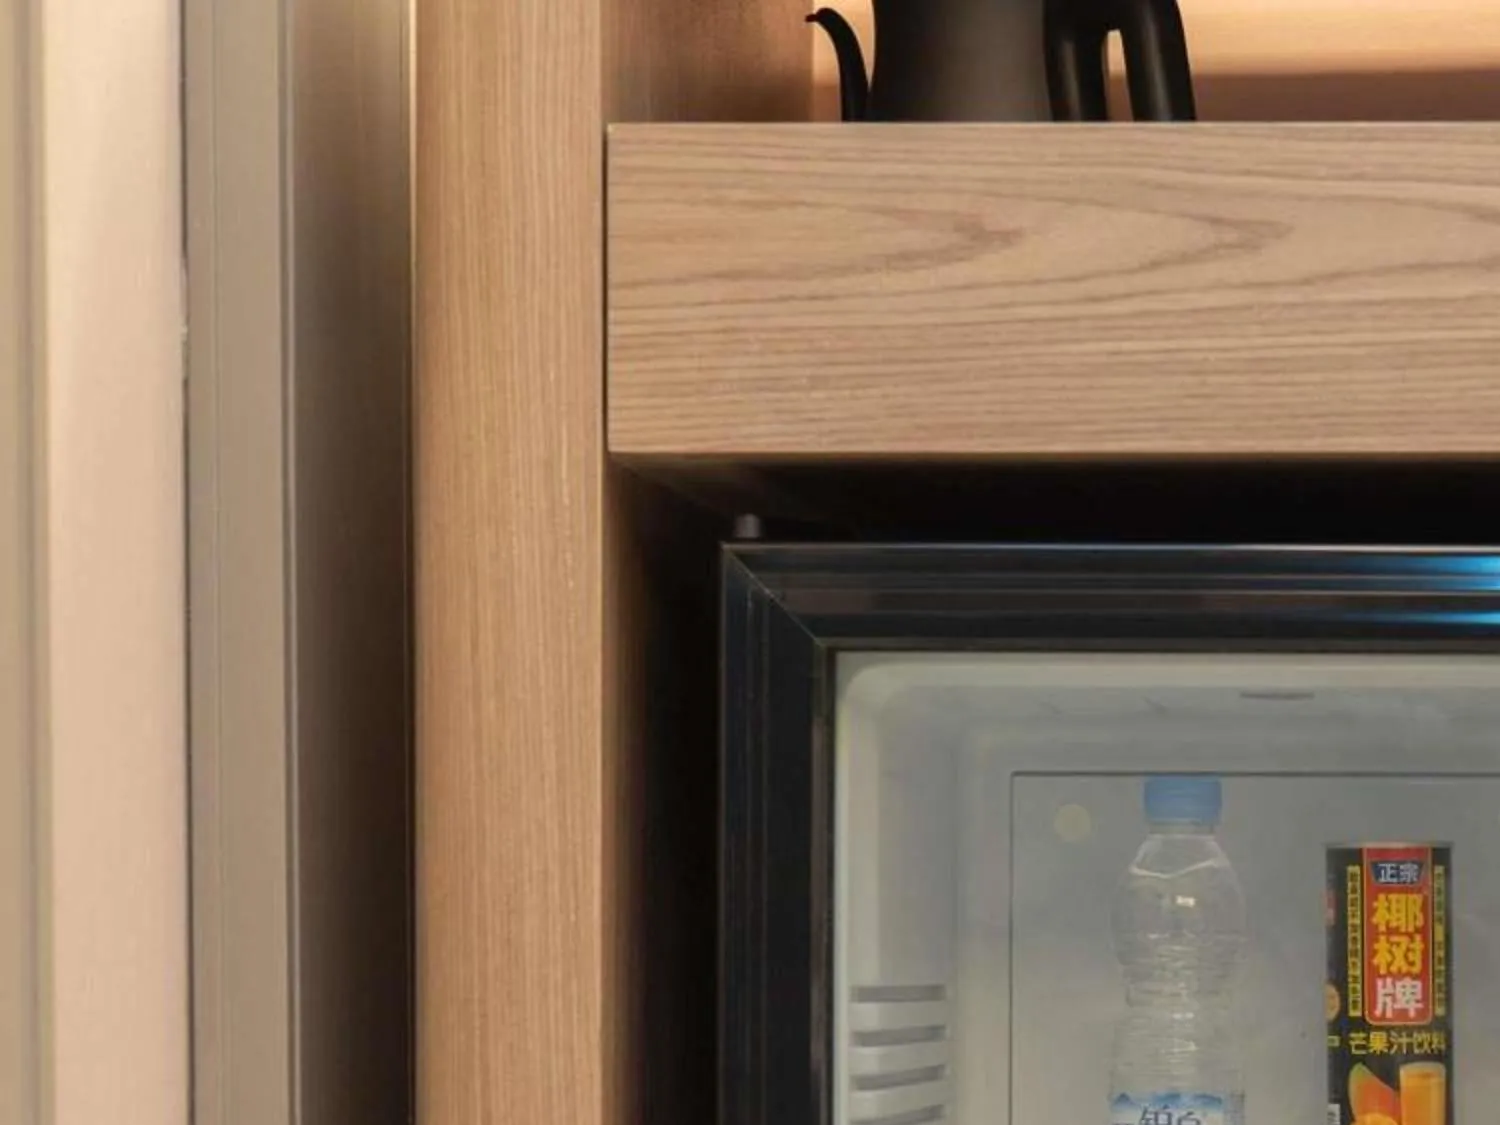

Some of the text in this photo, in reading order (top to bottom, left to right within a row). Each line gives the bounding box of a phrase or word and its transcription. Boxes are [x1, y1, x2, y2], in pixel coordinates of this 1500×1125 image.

[1378, 863, 1419, 882] 正宗
[1372, 892, 1425, 1019] 椰树牌
[1349, 1031, 1446, 1055] 芒果汁饮料
